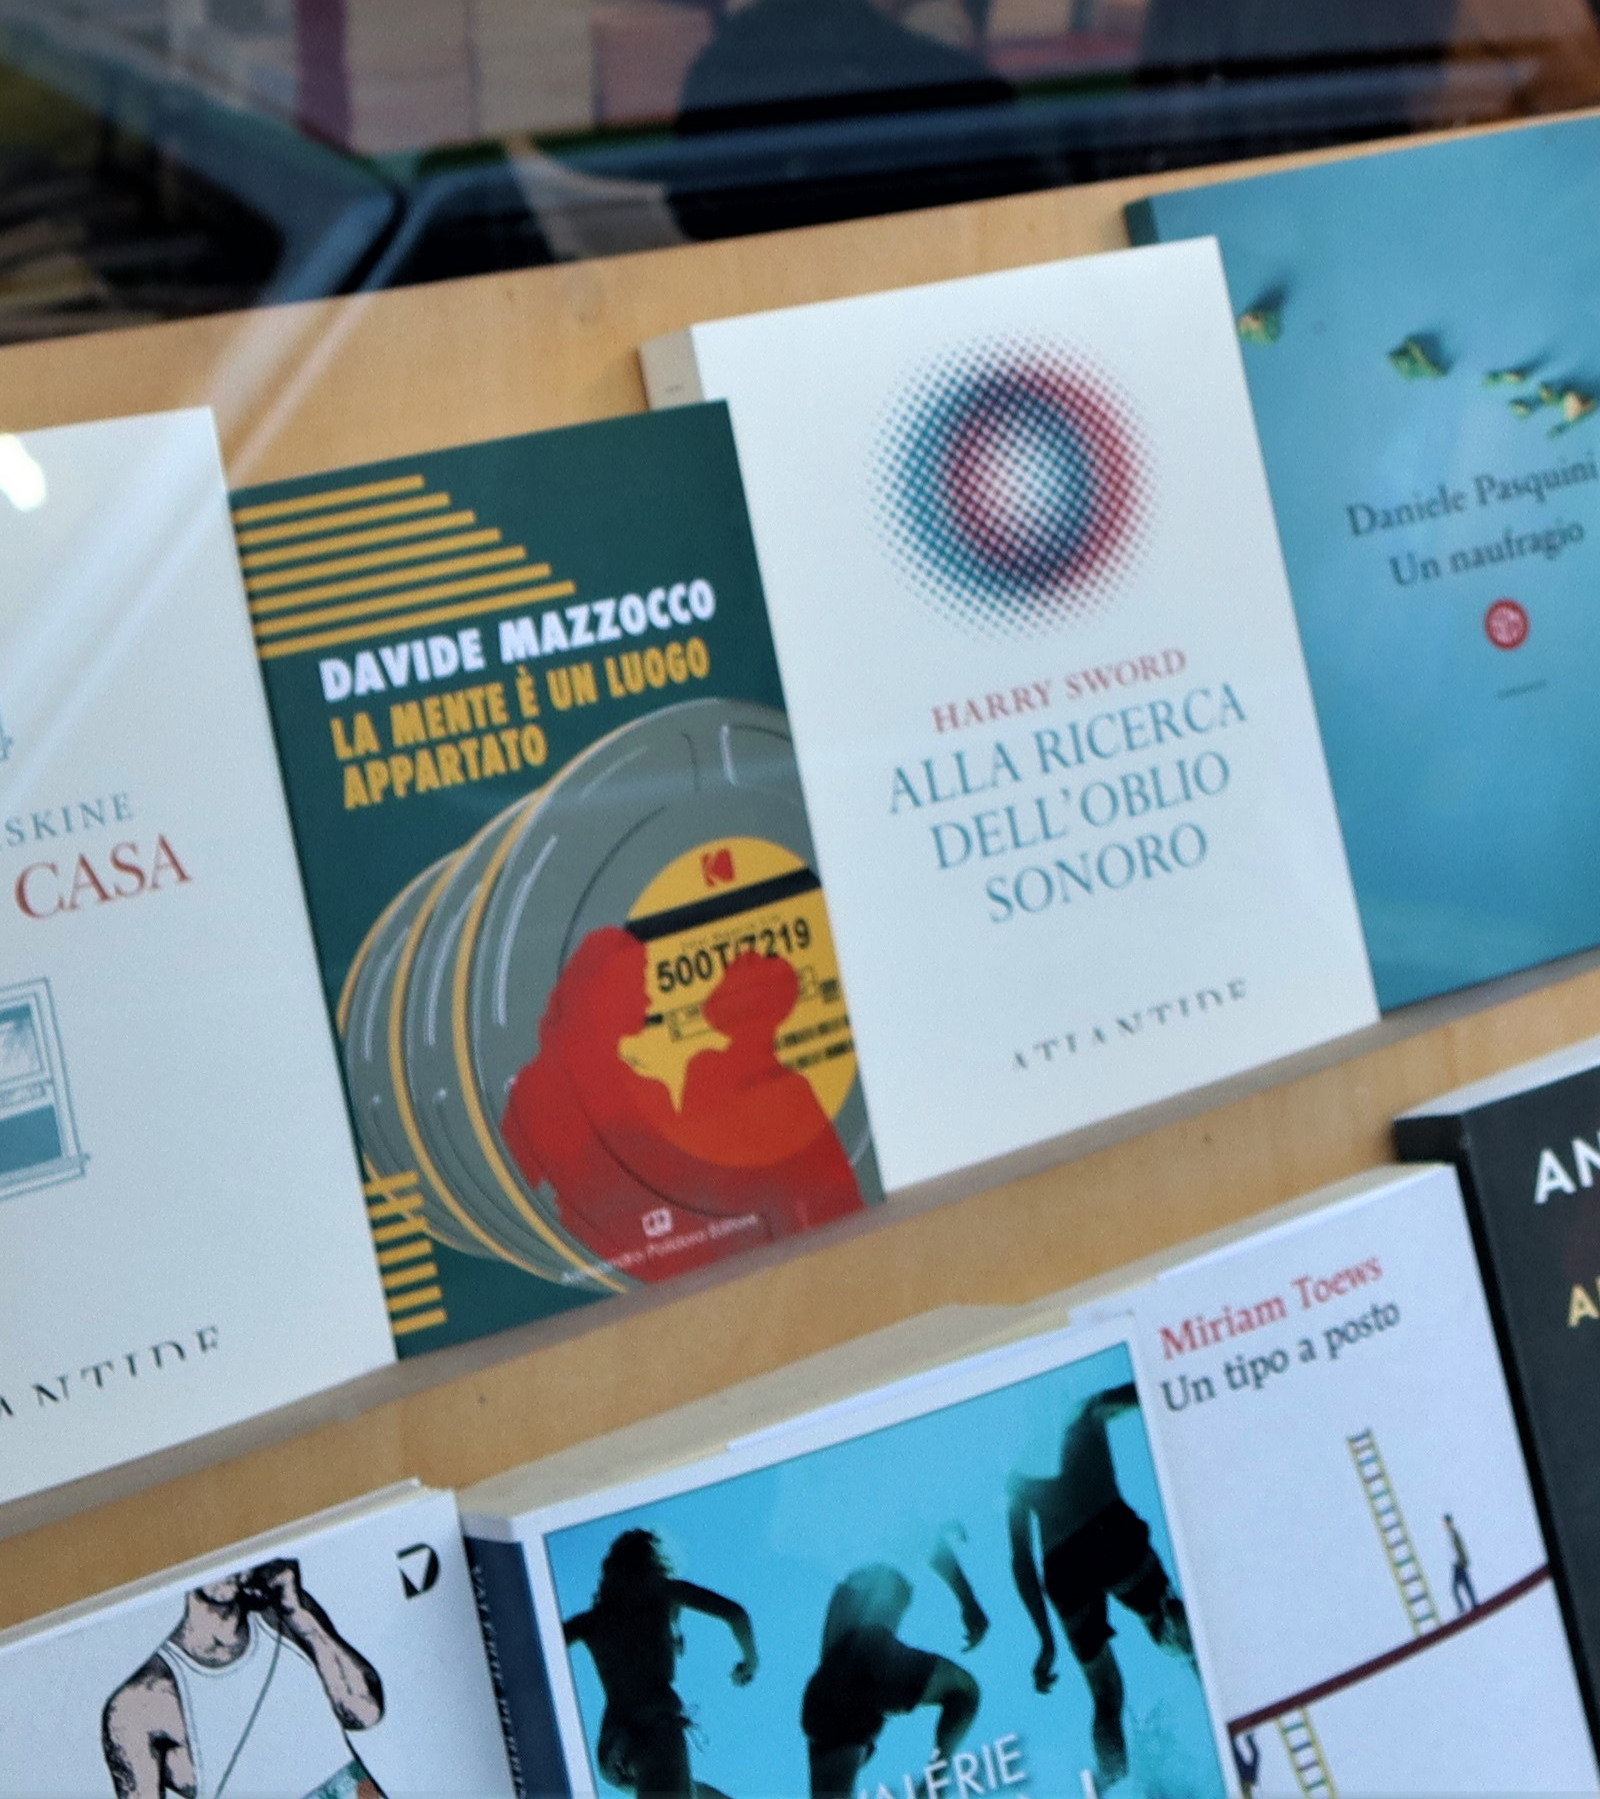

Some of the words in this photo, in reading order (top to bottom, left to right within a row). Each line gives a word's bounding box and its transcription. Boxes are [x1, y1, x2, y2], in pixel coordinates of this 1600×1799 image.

[1345, 489, 1465, 538] Daniele
[1475, 456, 1600, 513] Pasquini
[1390, 552, 1441, 587] Un
[1450, 520, 1585, 577] naufragio
[318, 628, 486, 703] DAVIDE
[498, 579, 718, 662] MAZZOCCO
[931, 682, 1053, 736] HARRY
[1065, 647, 1189, 703] SWORD
[330, 714, 382, 761] LA
[390, 688, 509, 757] MENTE
[515, 663, 541, 715] È
[547, 666, 599, 713] UN
[608, 639, 711, 700] LUOGO
[887, 743, 1023, 816] ALLA
[1035, 682, 1249, 774] RICERCA
[343, 725, 548, 811] APPARTATO
[929, 749, 1232, 872] DELL'OBLIO
[14, 832, 193, 922] CASA
[984, 821, 1211, 924] SONORO
[1157, 1292, 1287, 1361] Miriam
[1291, 1254, 1384, 1311] Toews
[1160, 1374, 1217, 1413] Un
[1222, 1344, 1290, 1392] tipo
[1298, 1335, 1317, 1363] a
[1323, 1299, 1402, 1359] posto
